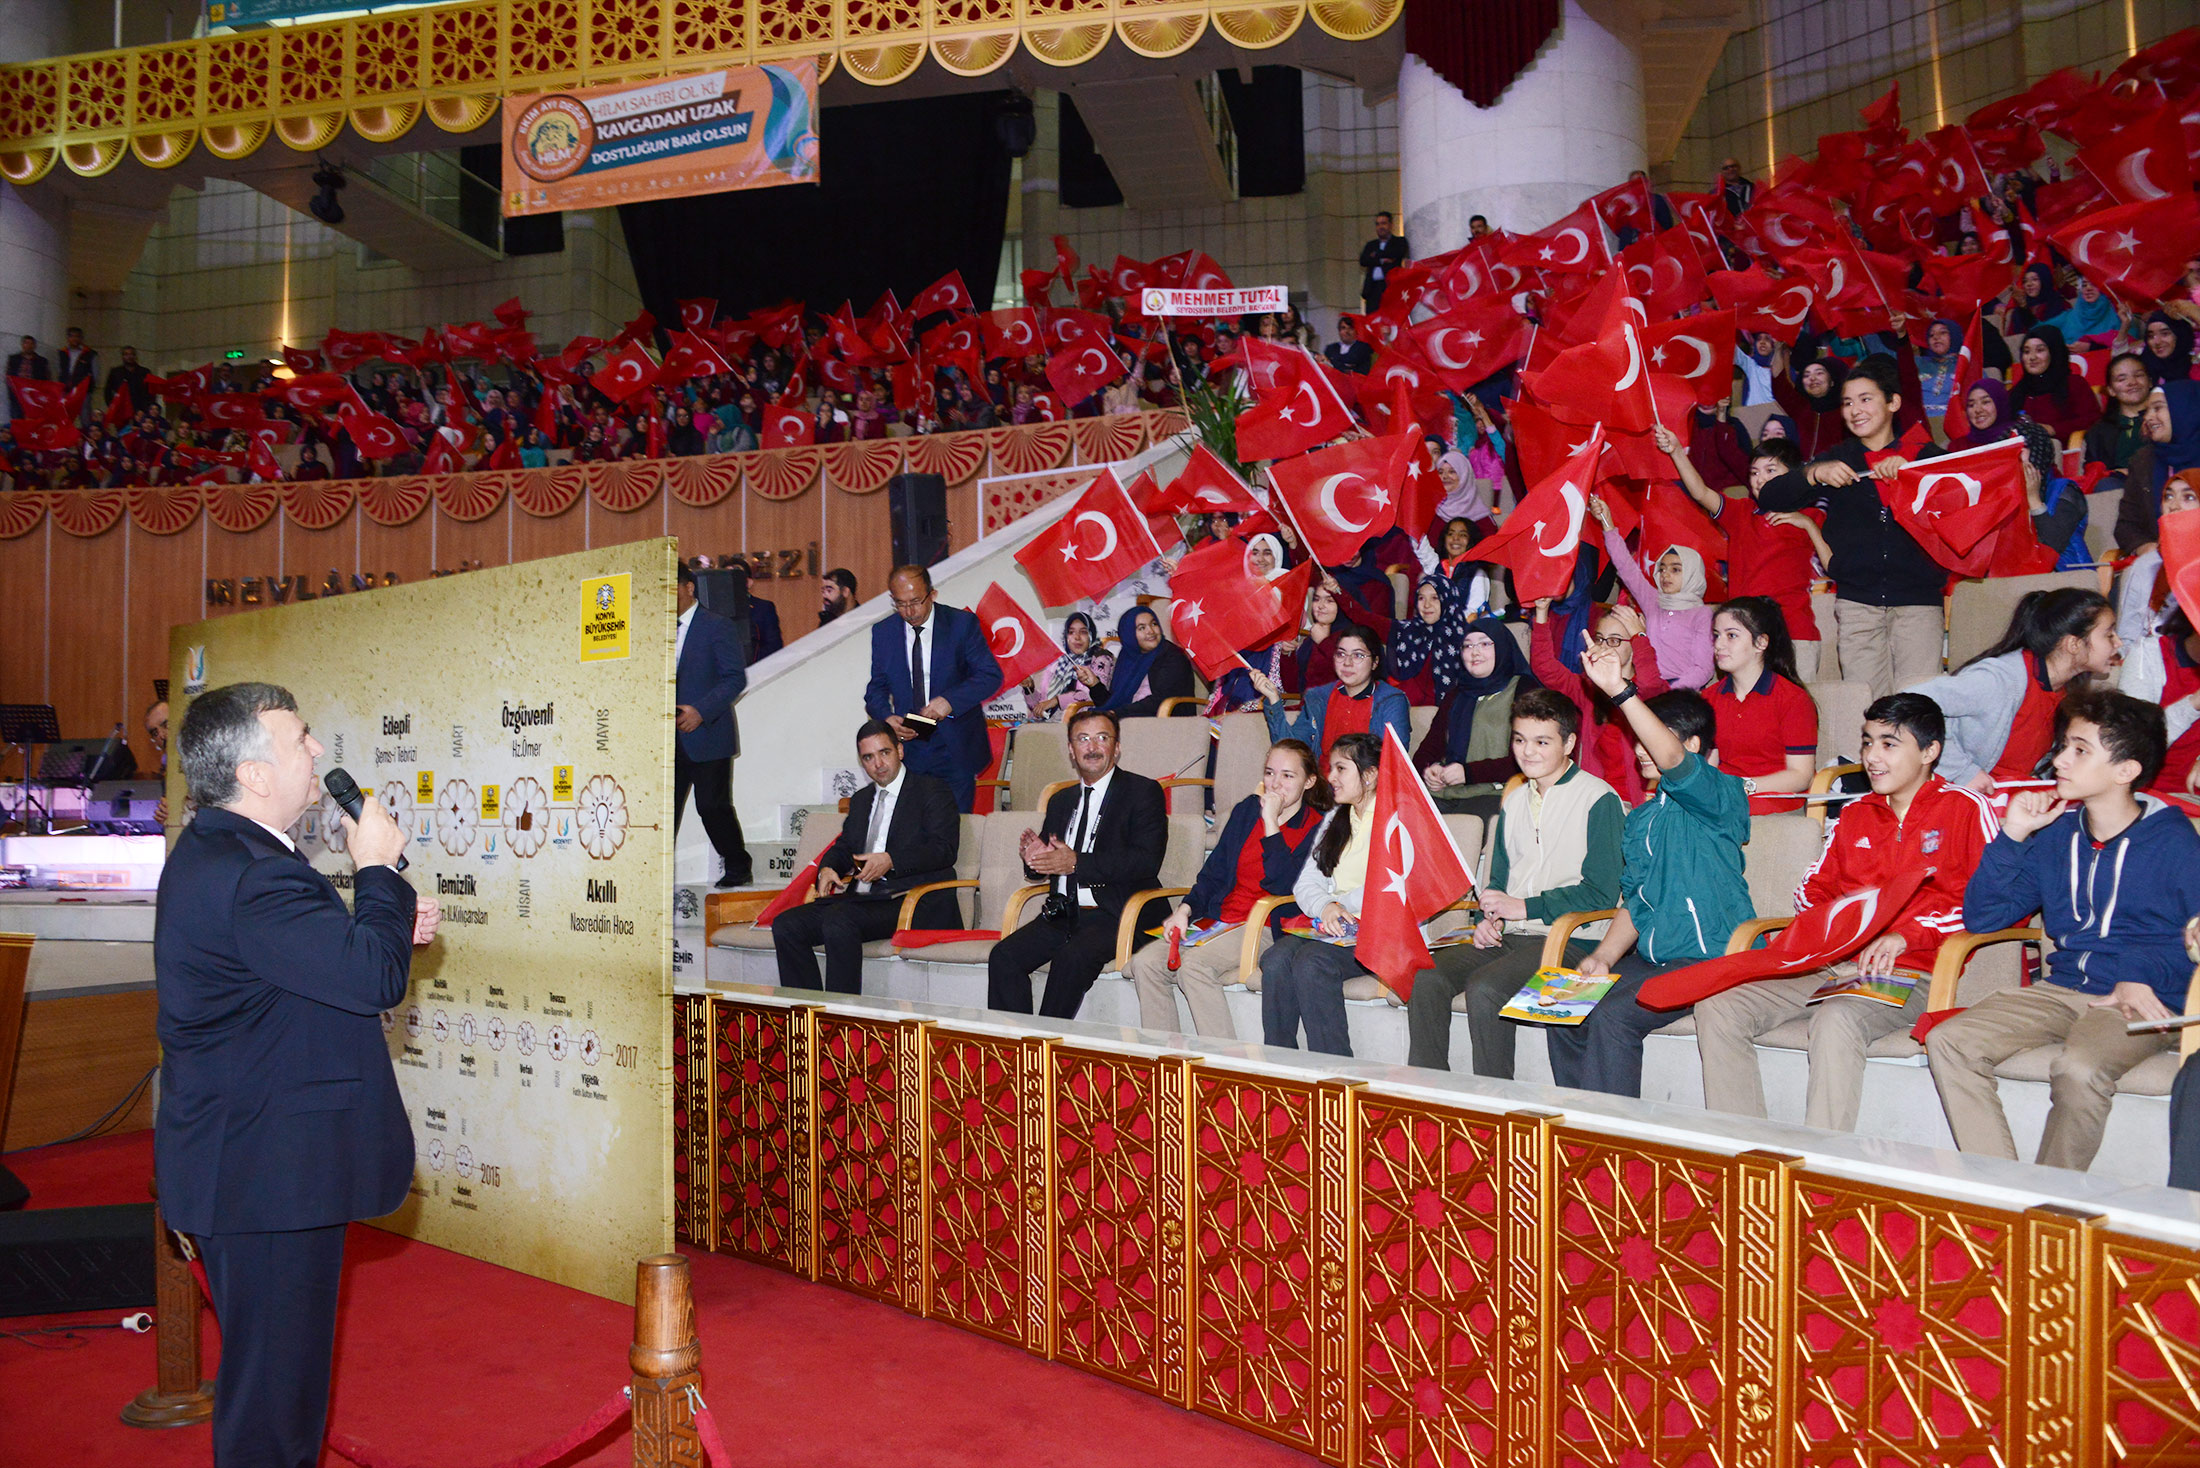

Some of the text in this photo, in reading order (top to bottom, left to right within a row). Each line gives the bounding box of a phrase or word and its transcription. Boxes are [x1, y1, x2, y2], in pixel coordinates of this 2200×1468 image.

[597, 99, 736, 140] KAVGADAN UZAK
[592, 138, 671, 165] DOSTLUĞUN
[671, 129, 702, 149] BAKİ
[702, 122, 748, 142] OLSUN
[1172, 289, 1281, 306] MEHMET TUTAL
[585, 619, 626, 635] BÜYÜKŞEHİR
[595, 611, 615, 621] KONYA
[383, 713, 411, 740] Edepli
[502, 701, 554, 734] Özgüvenli
[596, 708, 610, 751] MAYIS
[334, 733, 344, 764] OCAK
[453, 724, 464, 758] MART
[436, 873, 477, 896] Temizlik
[586, 878, 618, 903] Akıllı
[517, 879, 531, 918] NİSAN
[570, 912, 634, 935] Nasreddin Hoca
[616, 1043, 638, 1070] 2017
[481, 1163, 501, 1187] 2015
